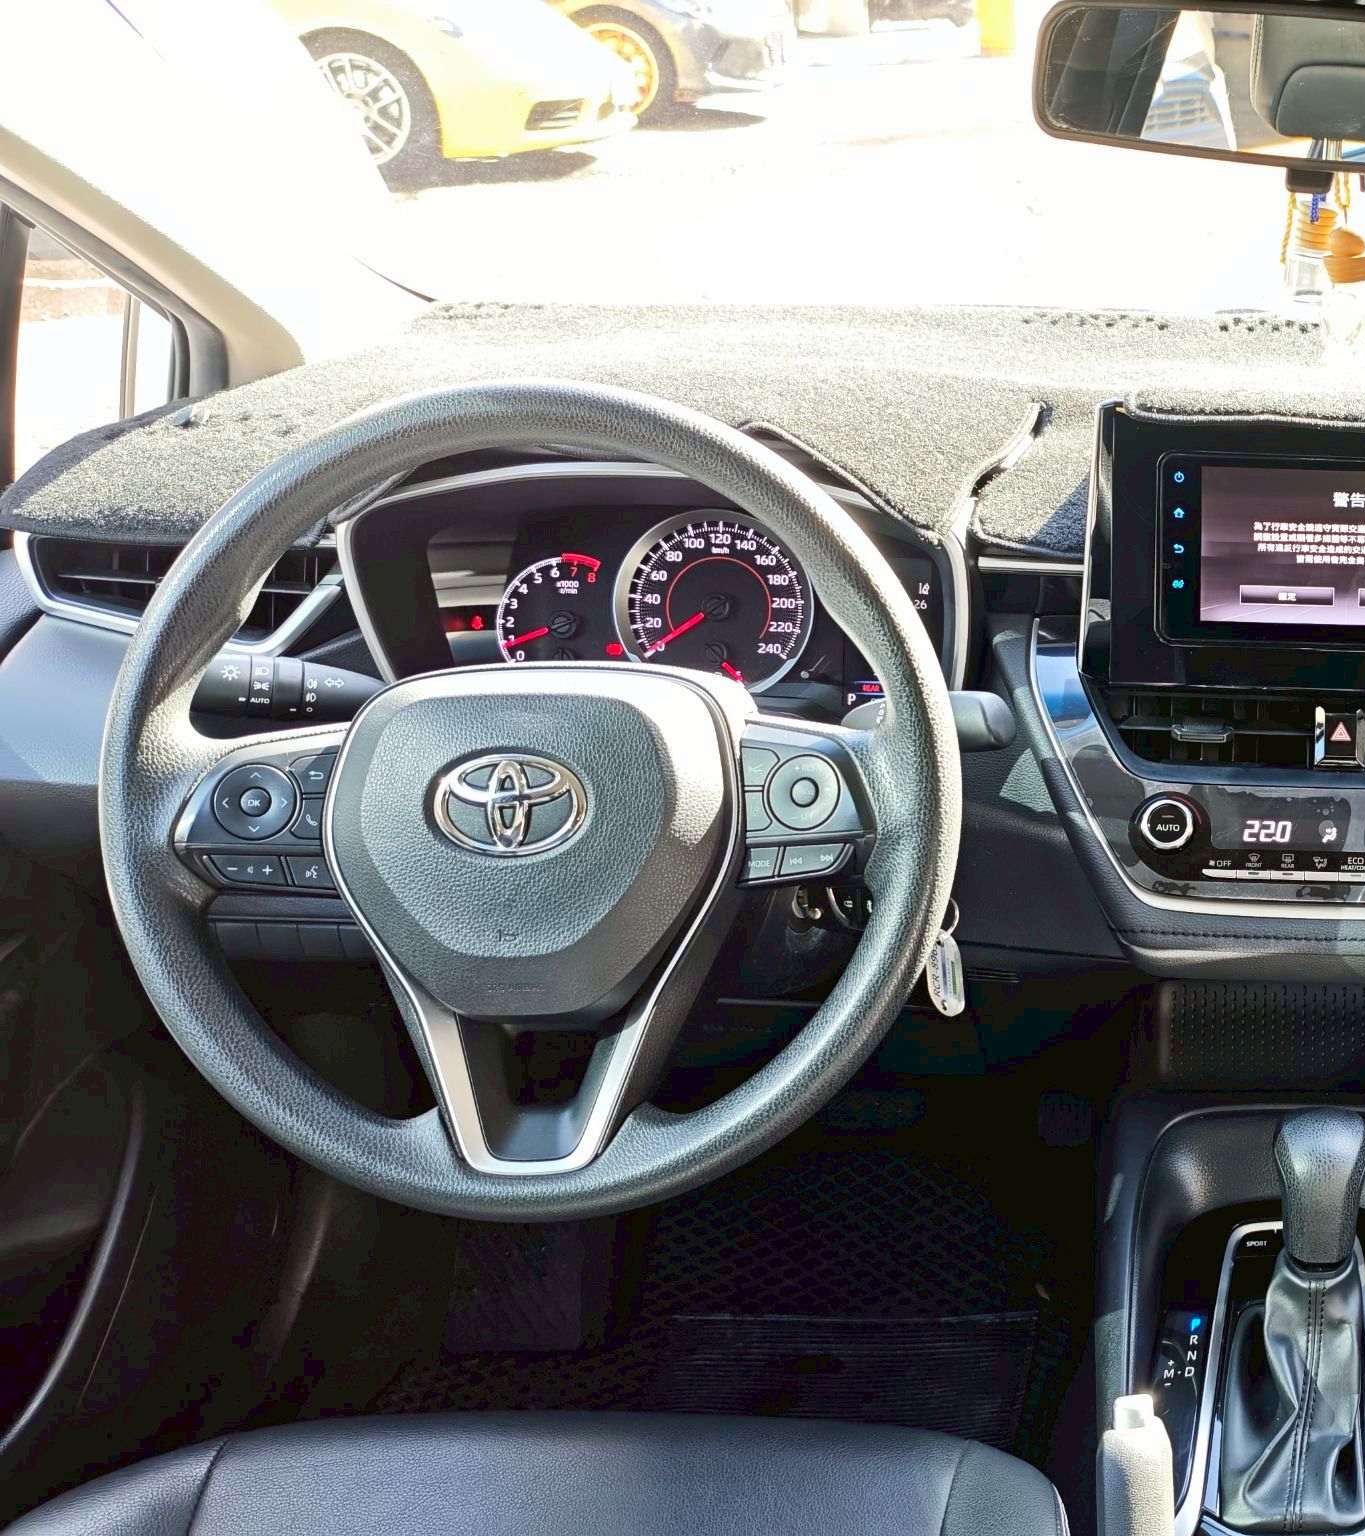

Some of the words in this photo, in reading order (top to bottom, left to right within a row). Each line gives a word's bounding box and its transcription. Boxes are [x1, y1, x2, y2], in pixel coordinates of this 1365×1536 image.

[683, 538, 705, 549] 100
[709, 533, 732, 545] 120
[735, 539, 757, 551] 140
[665, 550, 683, 562] 80
[754, 554, 777, 566] 160
[550, 567, 560, 578] 6
[569, 566, 578, 577] 7
[586, 572, 597, 583] 8
[650, 570, 668, 582] 60
[533, 572, 543, 584] 5
[766, 574, 789, 586] 180
[517, 583, 528, 595] 4
[509, 598, 518, 609] 3
[643, 593, 661, 605] 40
[771, 598, 796, 609] 200
[505, 616, 515, 628] 2
[645, 617, 662, 629] 20
[768, 621, 793, 633] 220
[757, 643, 782, 655] 240
[516, 650, 525, 661] 0
[847, 693, 857, 706] P
[249, 799, 261, 807] OK
[1156, 824, 1180, 832] AUTO
[1347, 857, 1365, 865] ECO
[1189, 1334, 1199, 1346] R
[1186, 1350, 1198, 1361] N
[1163, 1368, 1175, 1379] M
[1184, 1366, 1195, 1377] D
